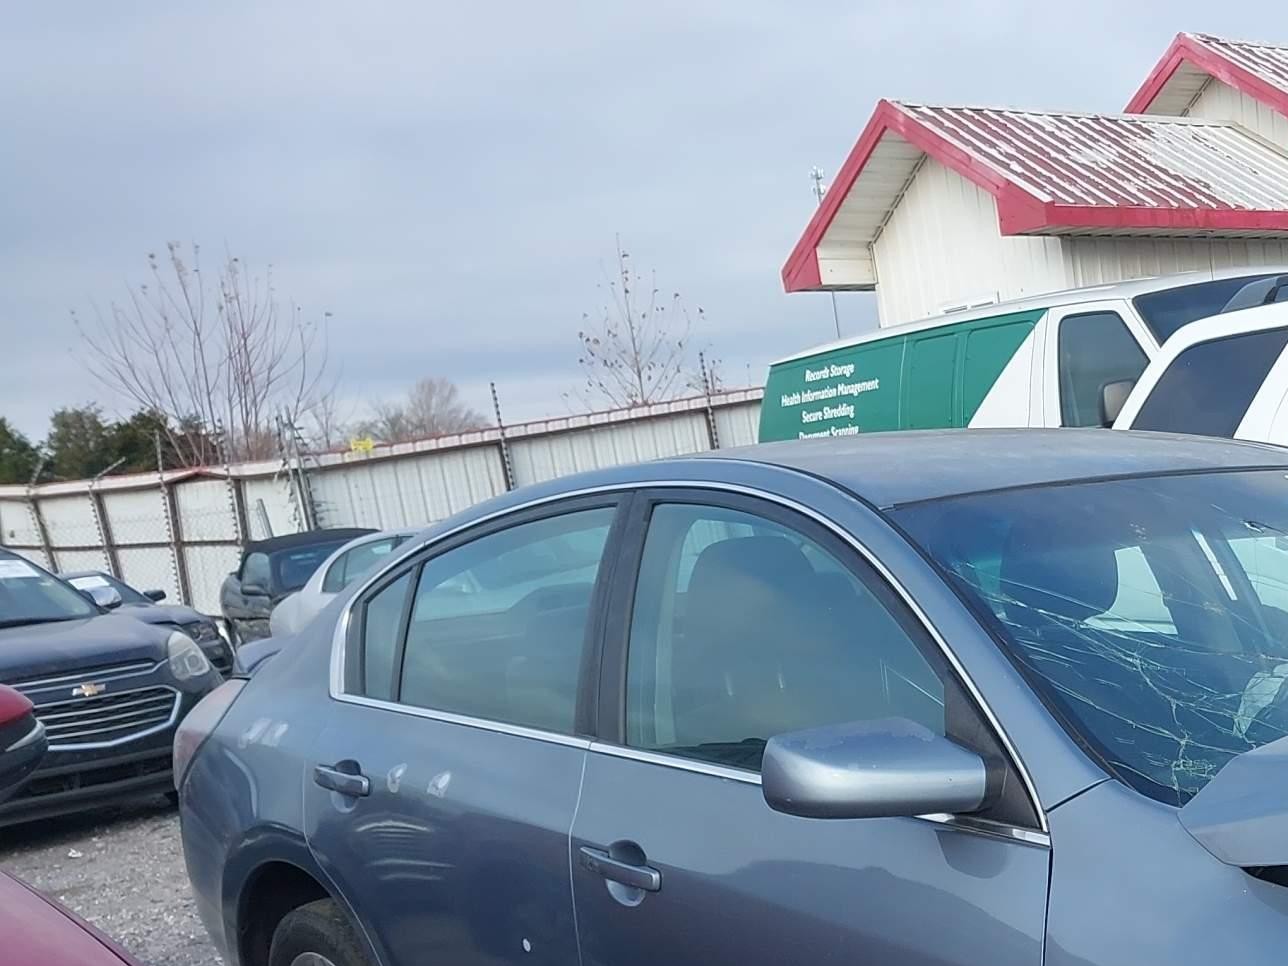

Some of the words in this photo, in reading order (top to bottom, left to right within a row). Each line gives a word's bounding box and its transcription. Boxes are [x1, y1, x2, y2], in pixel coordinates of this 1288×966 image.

[805, 367, 830, 382] Records
[830, 363, 855, 377] Storage
[781, 392, 801, 407] Health
[801, 386, 837, 403] Information
[837, 378, 879, 396] Management
[801, 410, 823, 423] Secure
[823, 404, 855, 418] Shredding
